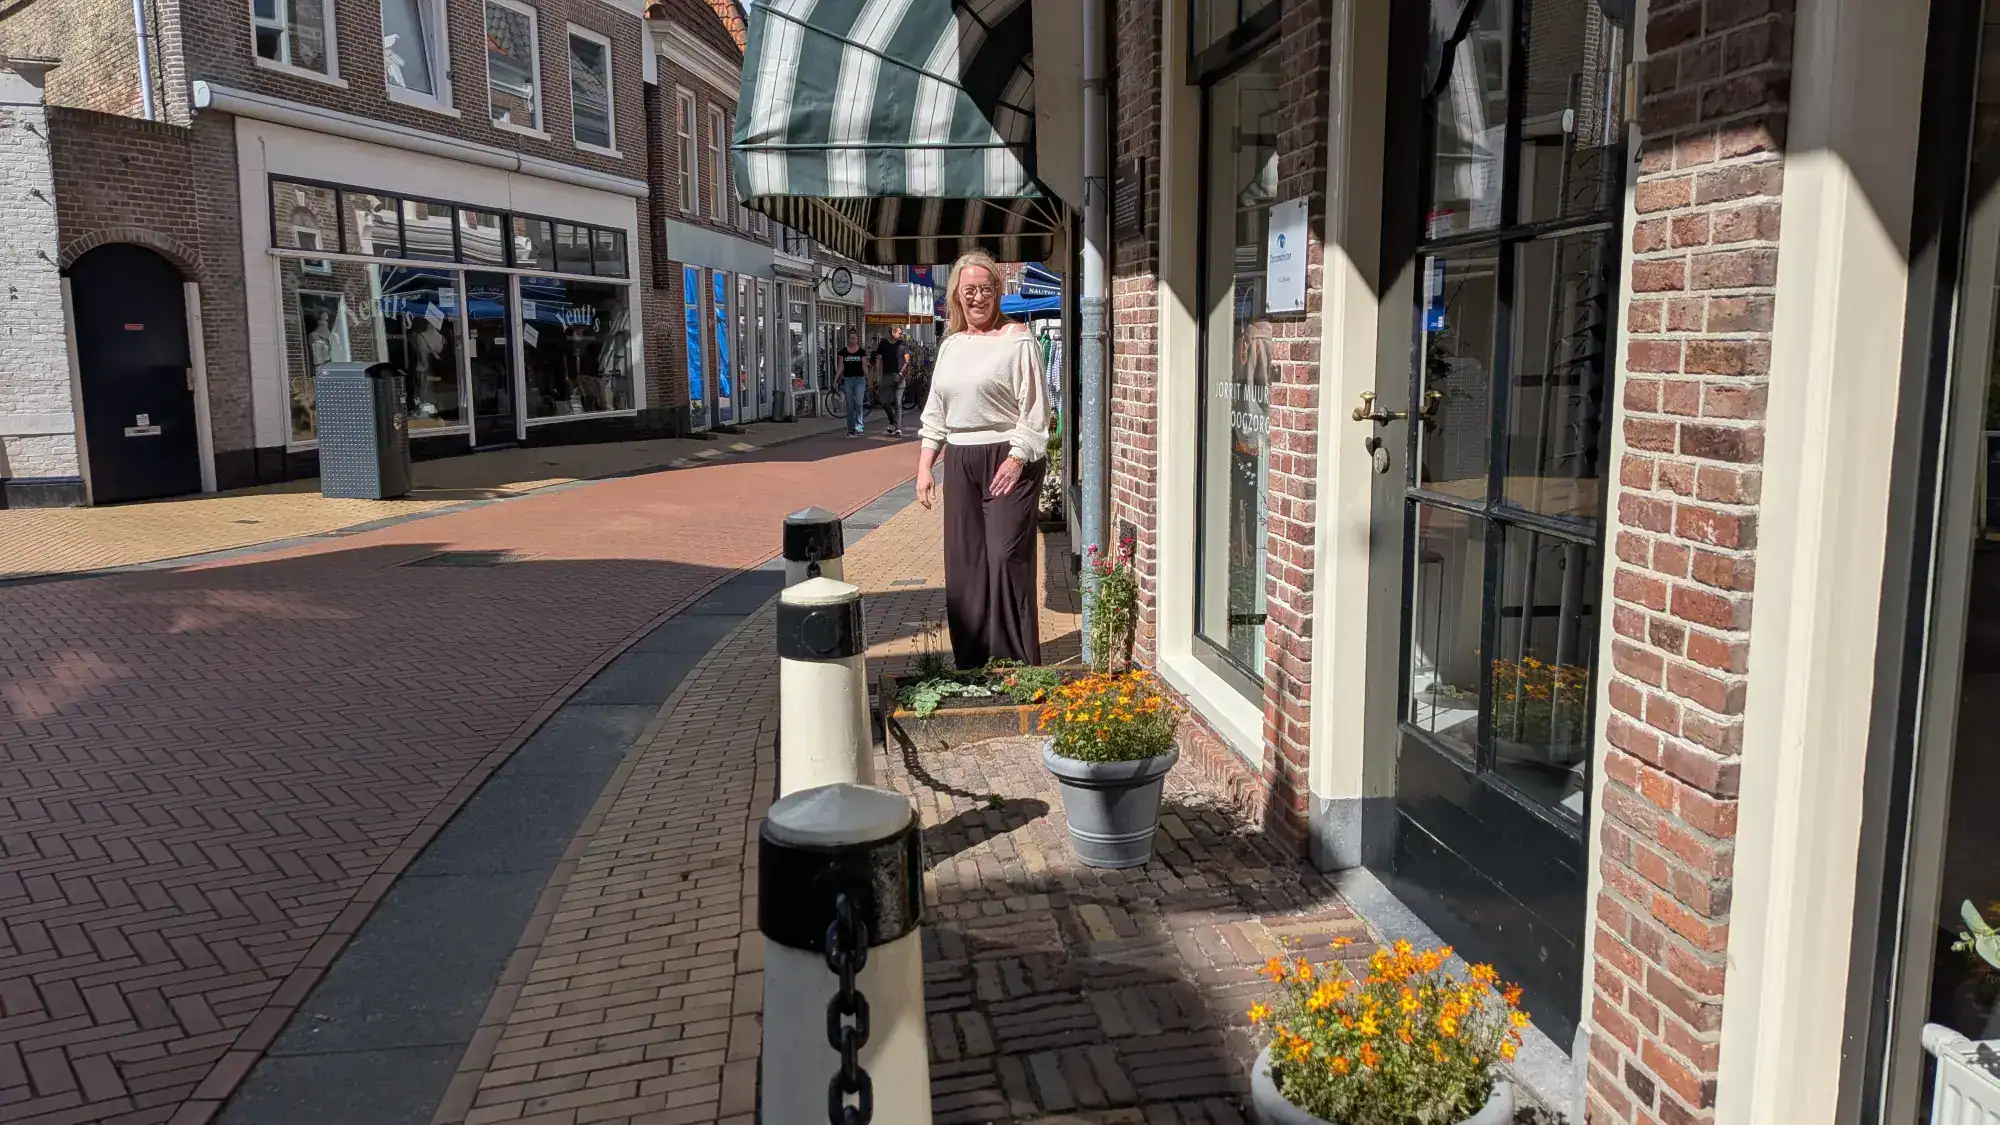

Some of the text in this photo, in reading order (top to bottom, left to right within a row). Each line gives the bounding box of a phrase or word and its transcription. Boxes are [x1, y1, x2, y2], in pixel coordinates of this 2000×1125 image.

[1028, 288, 1055, 296] NAUTIC
[555, 304, 600, 333] Yentl's
[1215, 380, 1242, 401] JORRIT
